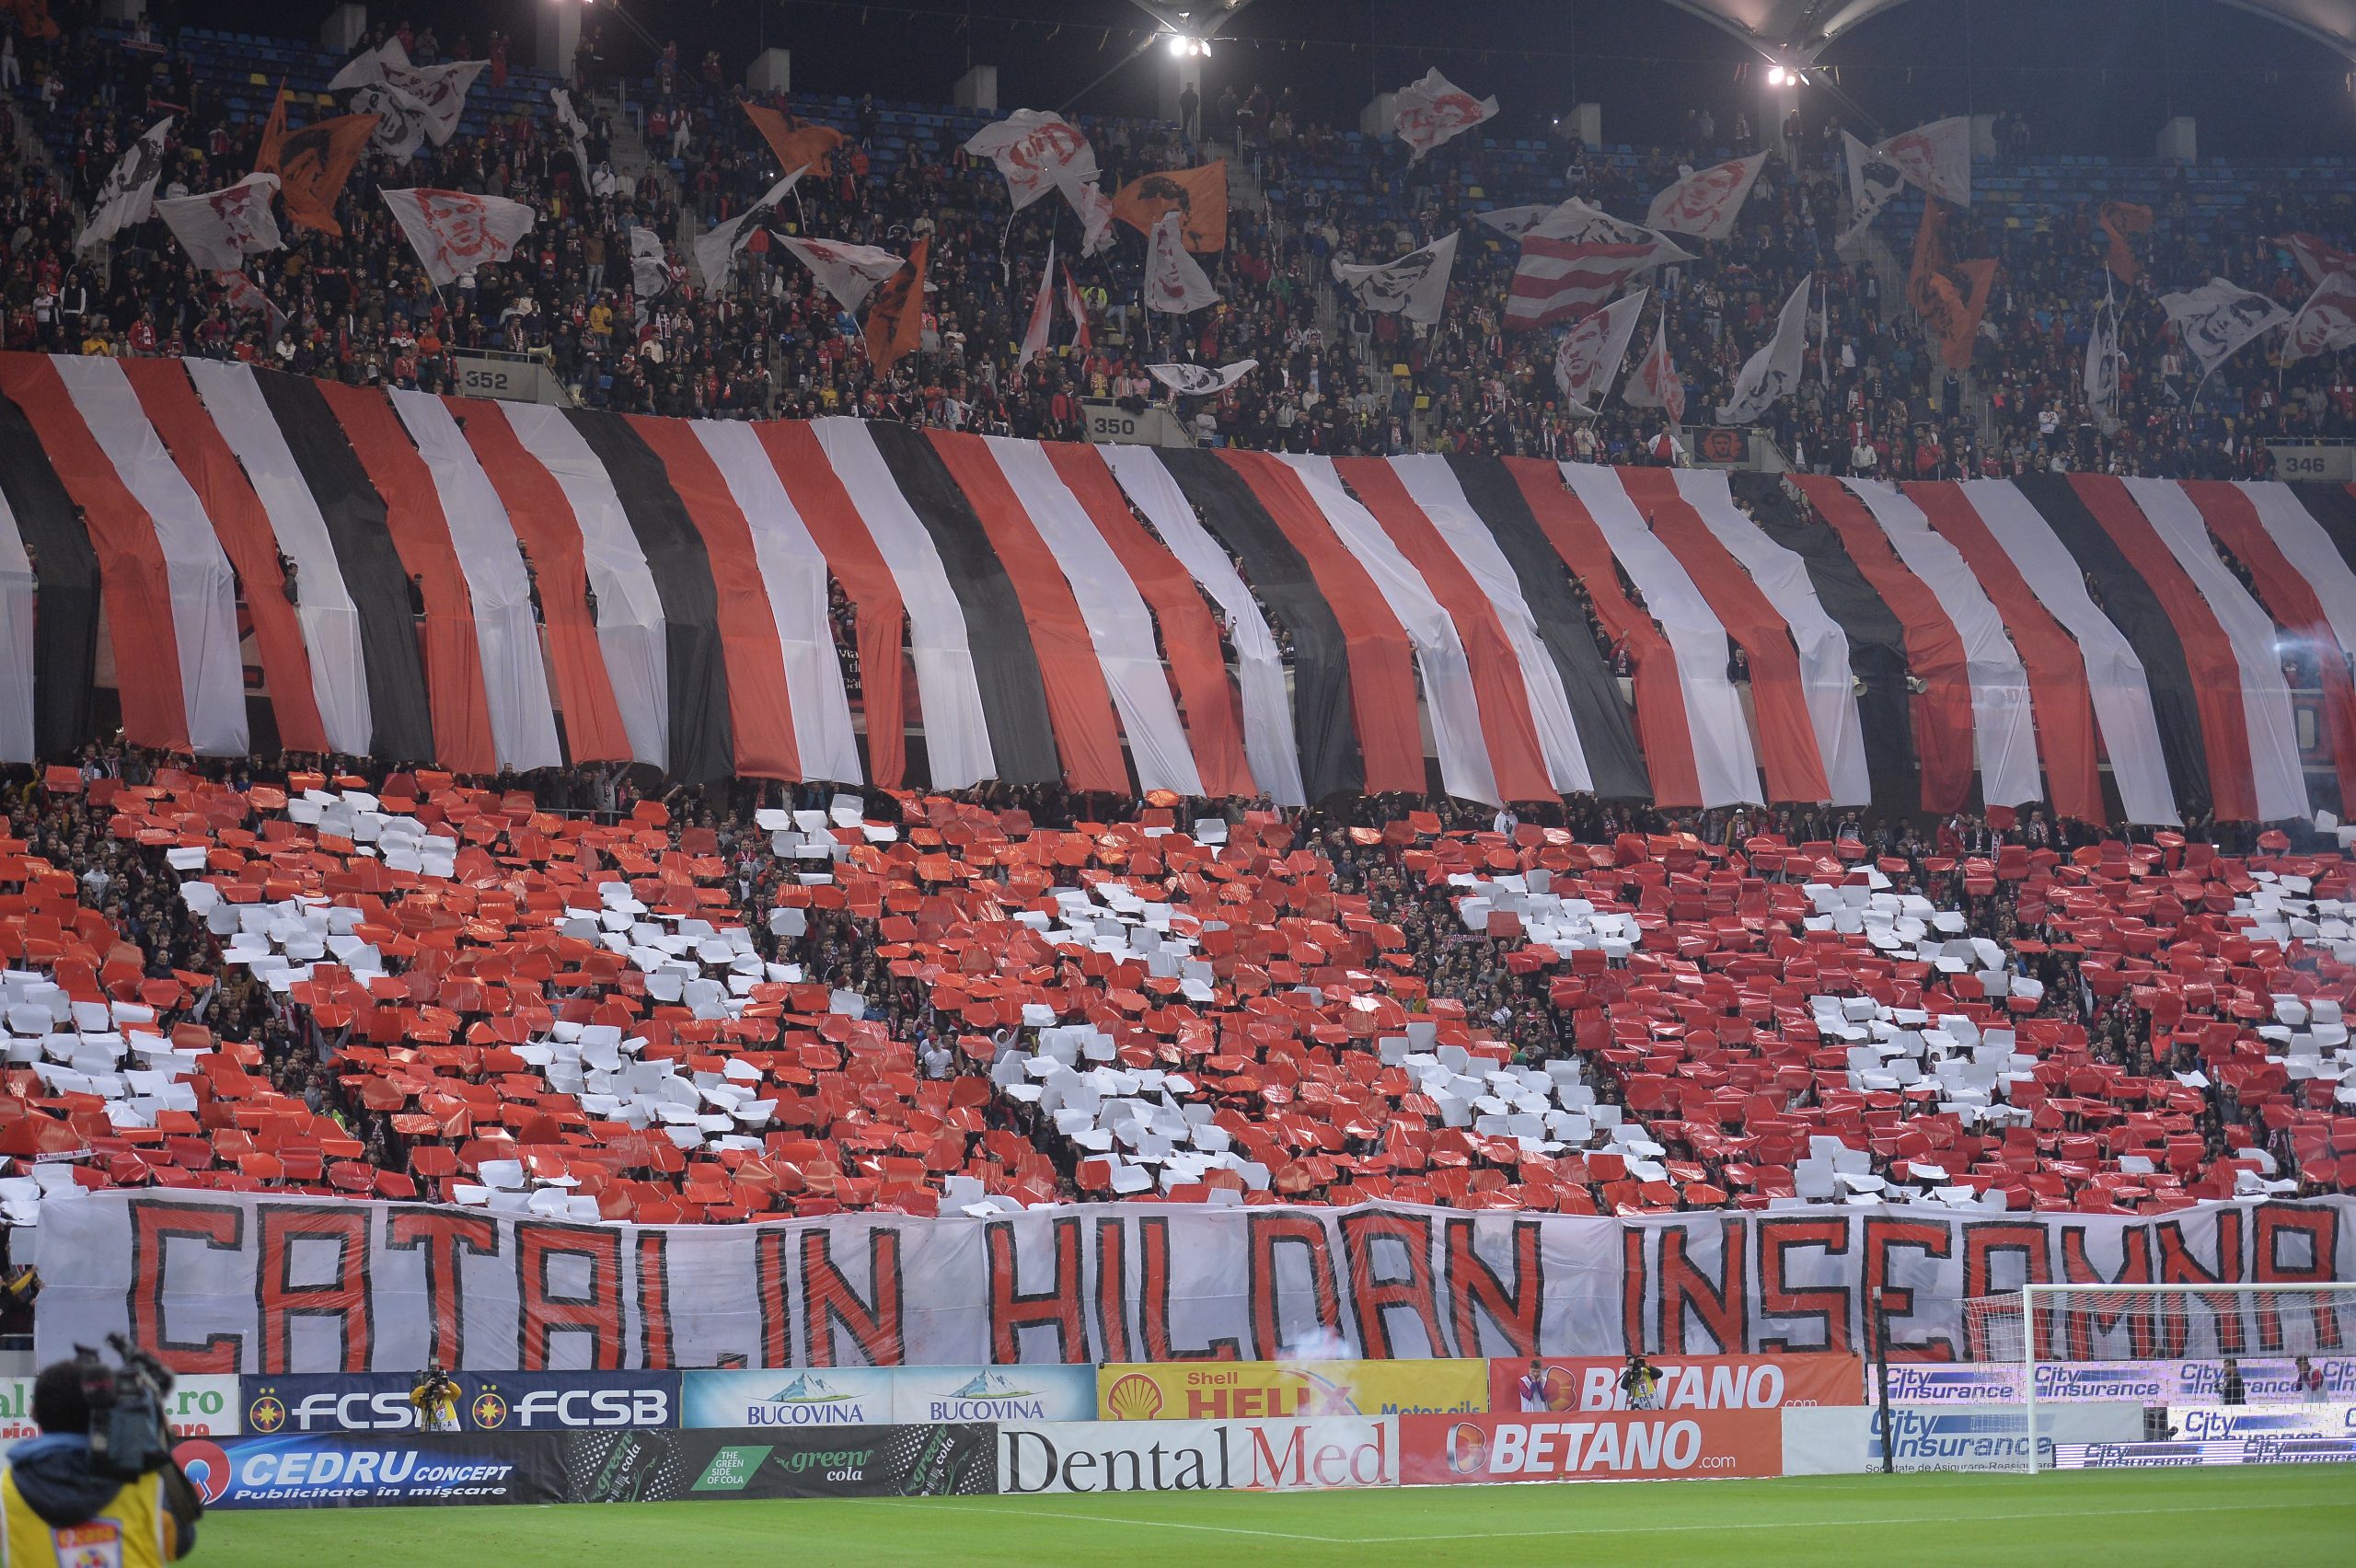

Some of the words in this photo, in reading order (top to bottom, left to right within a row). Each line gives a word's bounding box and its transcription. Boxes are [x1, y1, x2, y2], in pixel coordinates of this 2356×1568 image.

[467, 371, 508, 390] 352
[1094, 418, 1135, 435] 350
[2286, 457, 2325, 472] 346
[127, 1199, 905, 1374] CATALIN
[985, 1210, 1544, 1364] HILDAN
[1187, 1371, 1239, 1385] Shell
[1887, 1367, 1932, 1388] City
[2035, 1366, 2081, 1385] City
[1898, 1383, 2014, 1399] Insurance
[2048, 1382, 2160, 1397] Insurance
[292, 1392, 422, 1430] FCS
[513, 1389, 668, 1426] FCSB
[930, 1401, 1045, 1421] BUCOVINA
[1186, 1384, 1360, 1420] HELIX
[1381, 1403, 1442, 1415] Motor
[747, 1404, 864, 1425] BUCOVINA
[2186, 1411, 2236, 1437] City
[1869, 1409, 1937, 1441] City
[722, 1451, 738, 1459] THE
[936, 1437, 955, 1465] cola
[1489, 1420, 1702, 1472] BETANO
[1889, 1435, 2052, 1458] Insurance
[597, 1429, 633, 1495] green
[622, 1444, 641, 1471] cola
[716, 1459, 744, 1468] GREEN
[785, 1449, 870, 1473] green
[912, 1424, 947, 1490] green
[1698, 1456, 1736, 1469] .com
[241, 1451, 418, 1485] CEDRU
[414, 1466, 512, 1482] CONCEPT
[711, 1468, 731, 1476] SIDE
[826, 1466, 862, 1482] cola
[707, 1476, 719, 1484] OF
[721, 1475, 744, 1484] COLA
[235, 1487, 368, 1500] Publicitate
[376, 1486, 400, 1497] în
